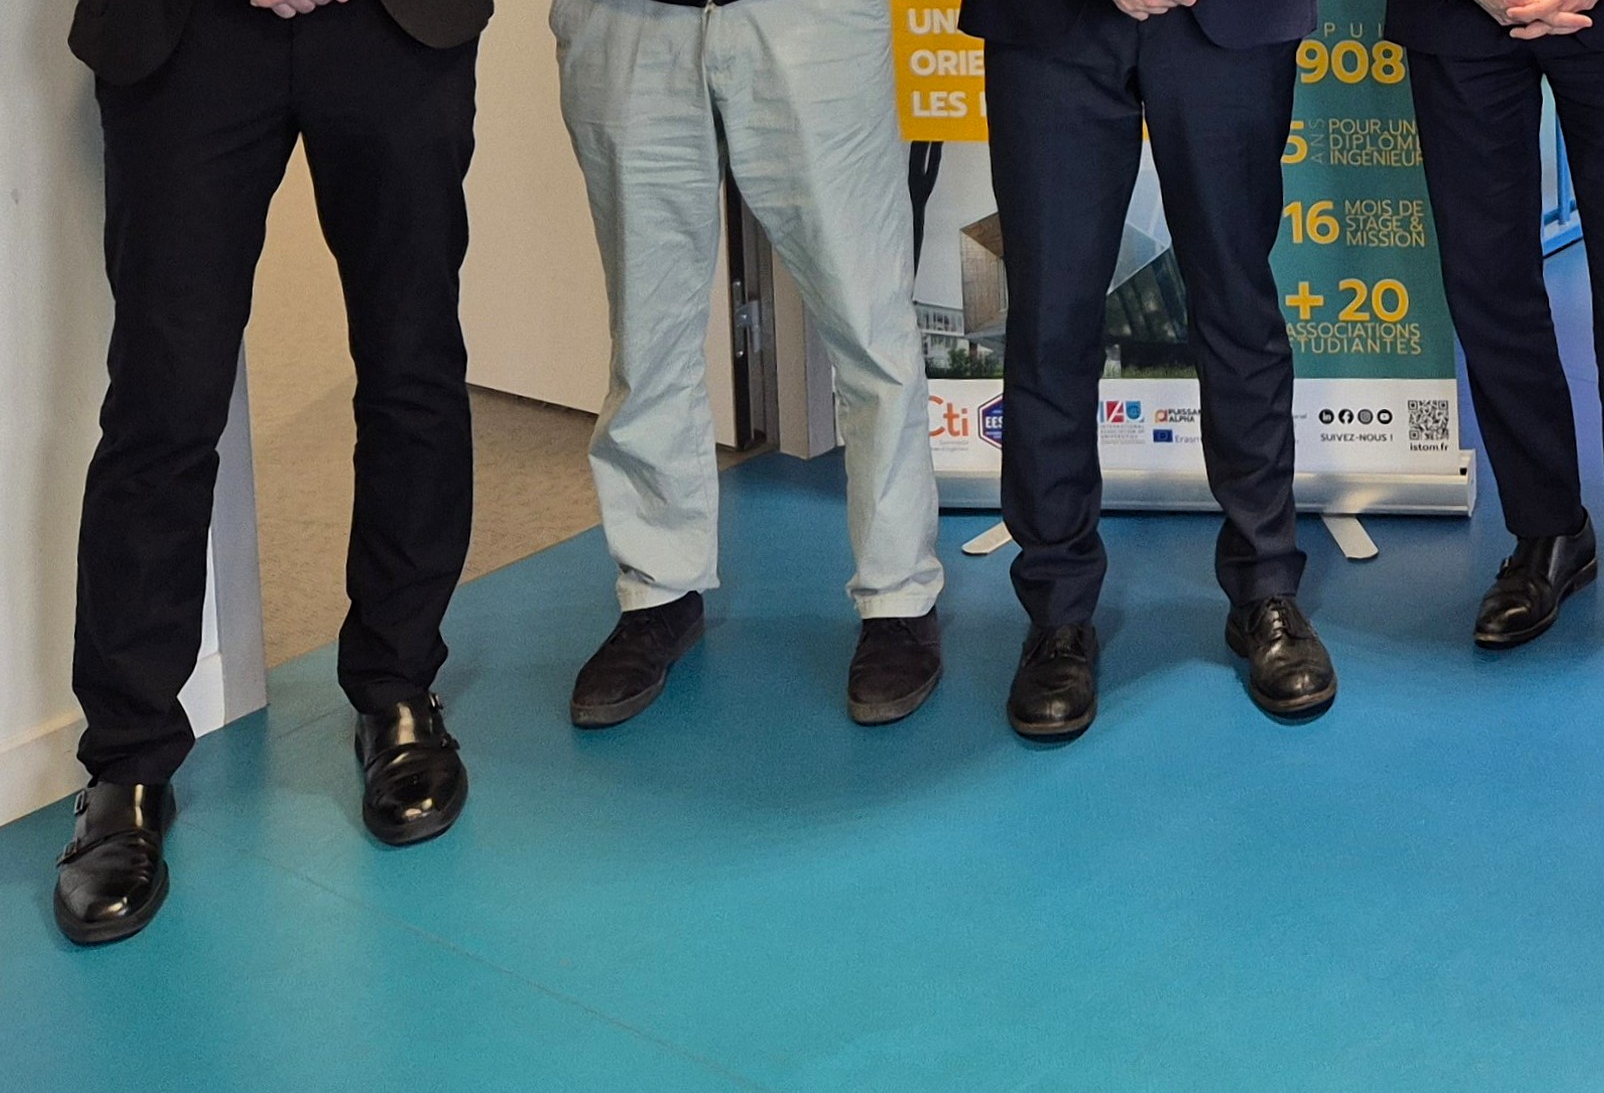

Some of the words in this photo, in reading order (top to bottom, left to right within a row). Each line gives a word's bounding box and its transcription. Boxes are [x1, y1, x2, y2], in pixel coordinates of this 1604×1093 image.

[907, 8, 960, 34] UN
[910, 49, 985, 77] ORIE
[1295, 40, 1406, 85] 908
[912, 91, 968, 117] LES
[1328, 119, 1380, 135] POUR
[1389, 120, 1417, 136] UN
[1280, 121, 1309, 164] 5
[1308, 118, 1326, 164] ANS
[1345, 200, 1391, 216] MOIS
[1400, 200, 1424, 217] DE
[1283, 200, 1340, 244] 16
[1346, 215, 1402, 232] STAGE
[1410, 216, 1424, 232] &
[1346, 231, 1426, 247] MISSION
[1285, 281, 1325, 320] +
[1338, 278, 1409, 322] 20
[1286, 322, 1421, 339] ASSOCIATIONS
[1294, 338, 1422, 355] TUDIANTES
[1168, 415, 1195, 423] ALPHA
[1320, 433, 1387, 442] SUIVEZ-NOUS
[1409, 442, 1449, 452] istom.fr
